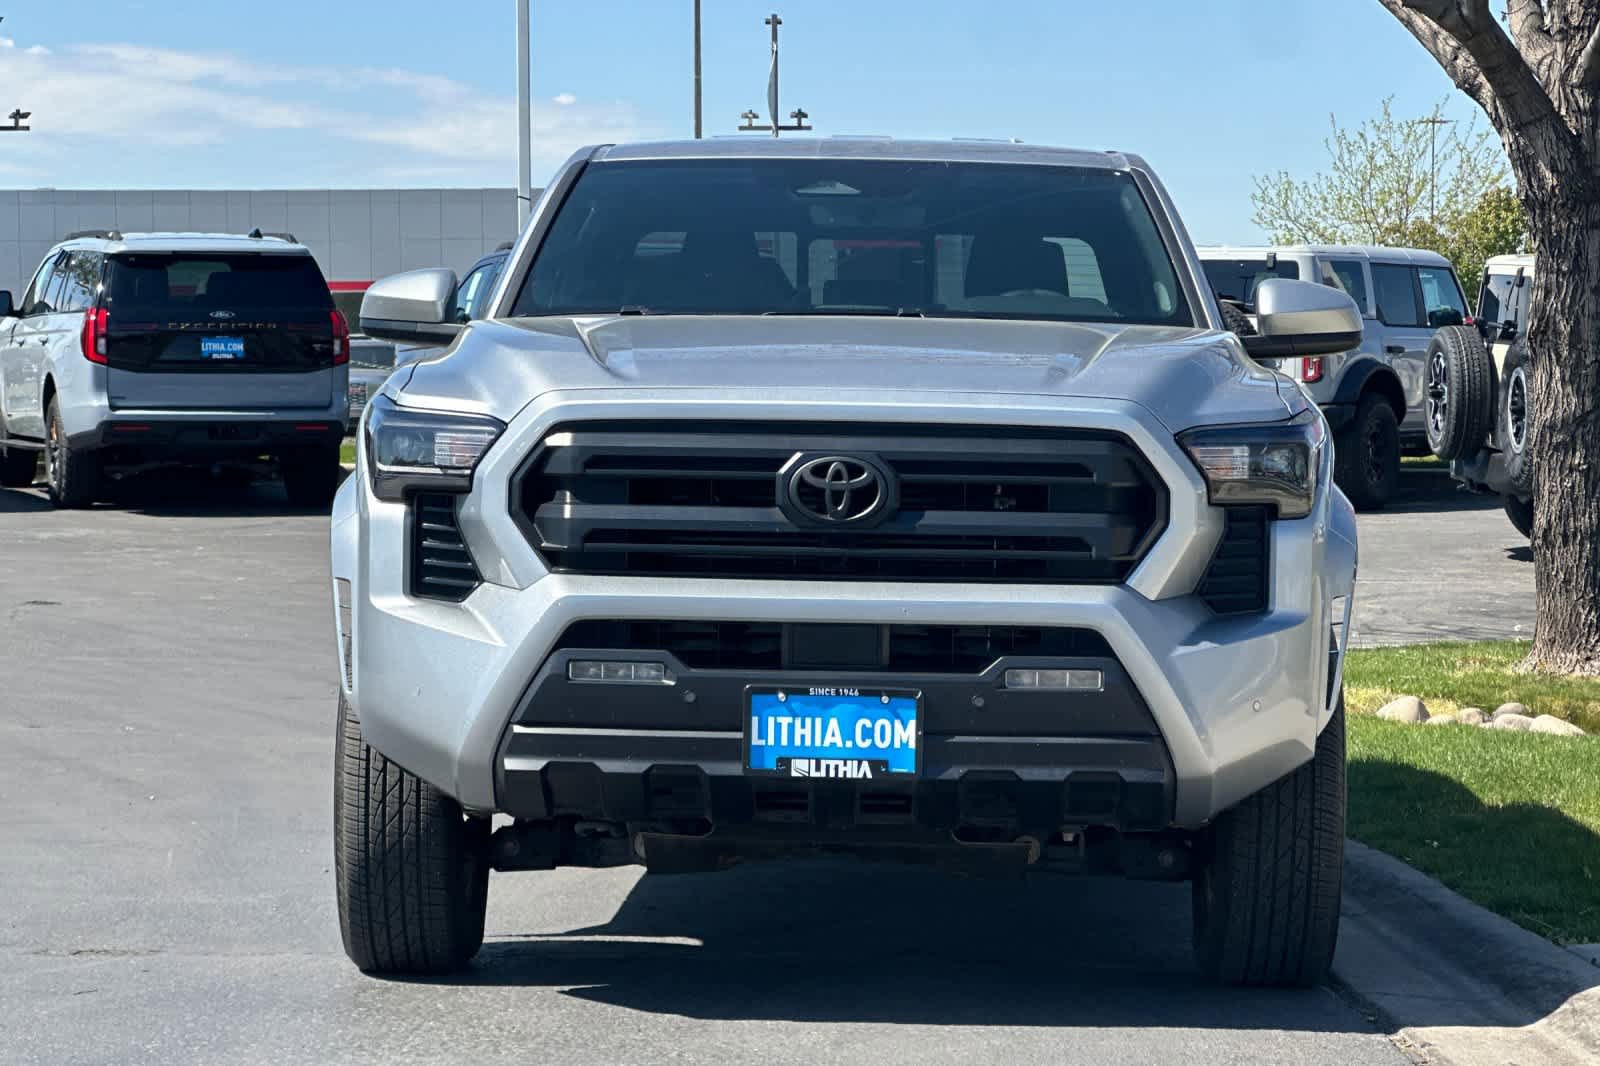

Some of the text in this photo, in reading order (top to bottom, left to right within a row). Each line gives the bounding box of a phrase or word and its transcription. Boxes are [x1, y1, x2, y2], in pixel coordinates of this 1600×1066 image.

[201, 342, 244, 352] LITHIA.COM
[809, 687, 860, 697] SINCE 1946
[751, 716, 917, 749] LITHIA.COM
[809, 758, 873, 779] LITHIA
